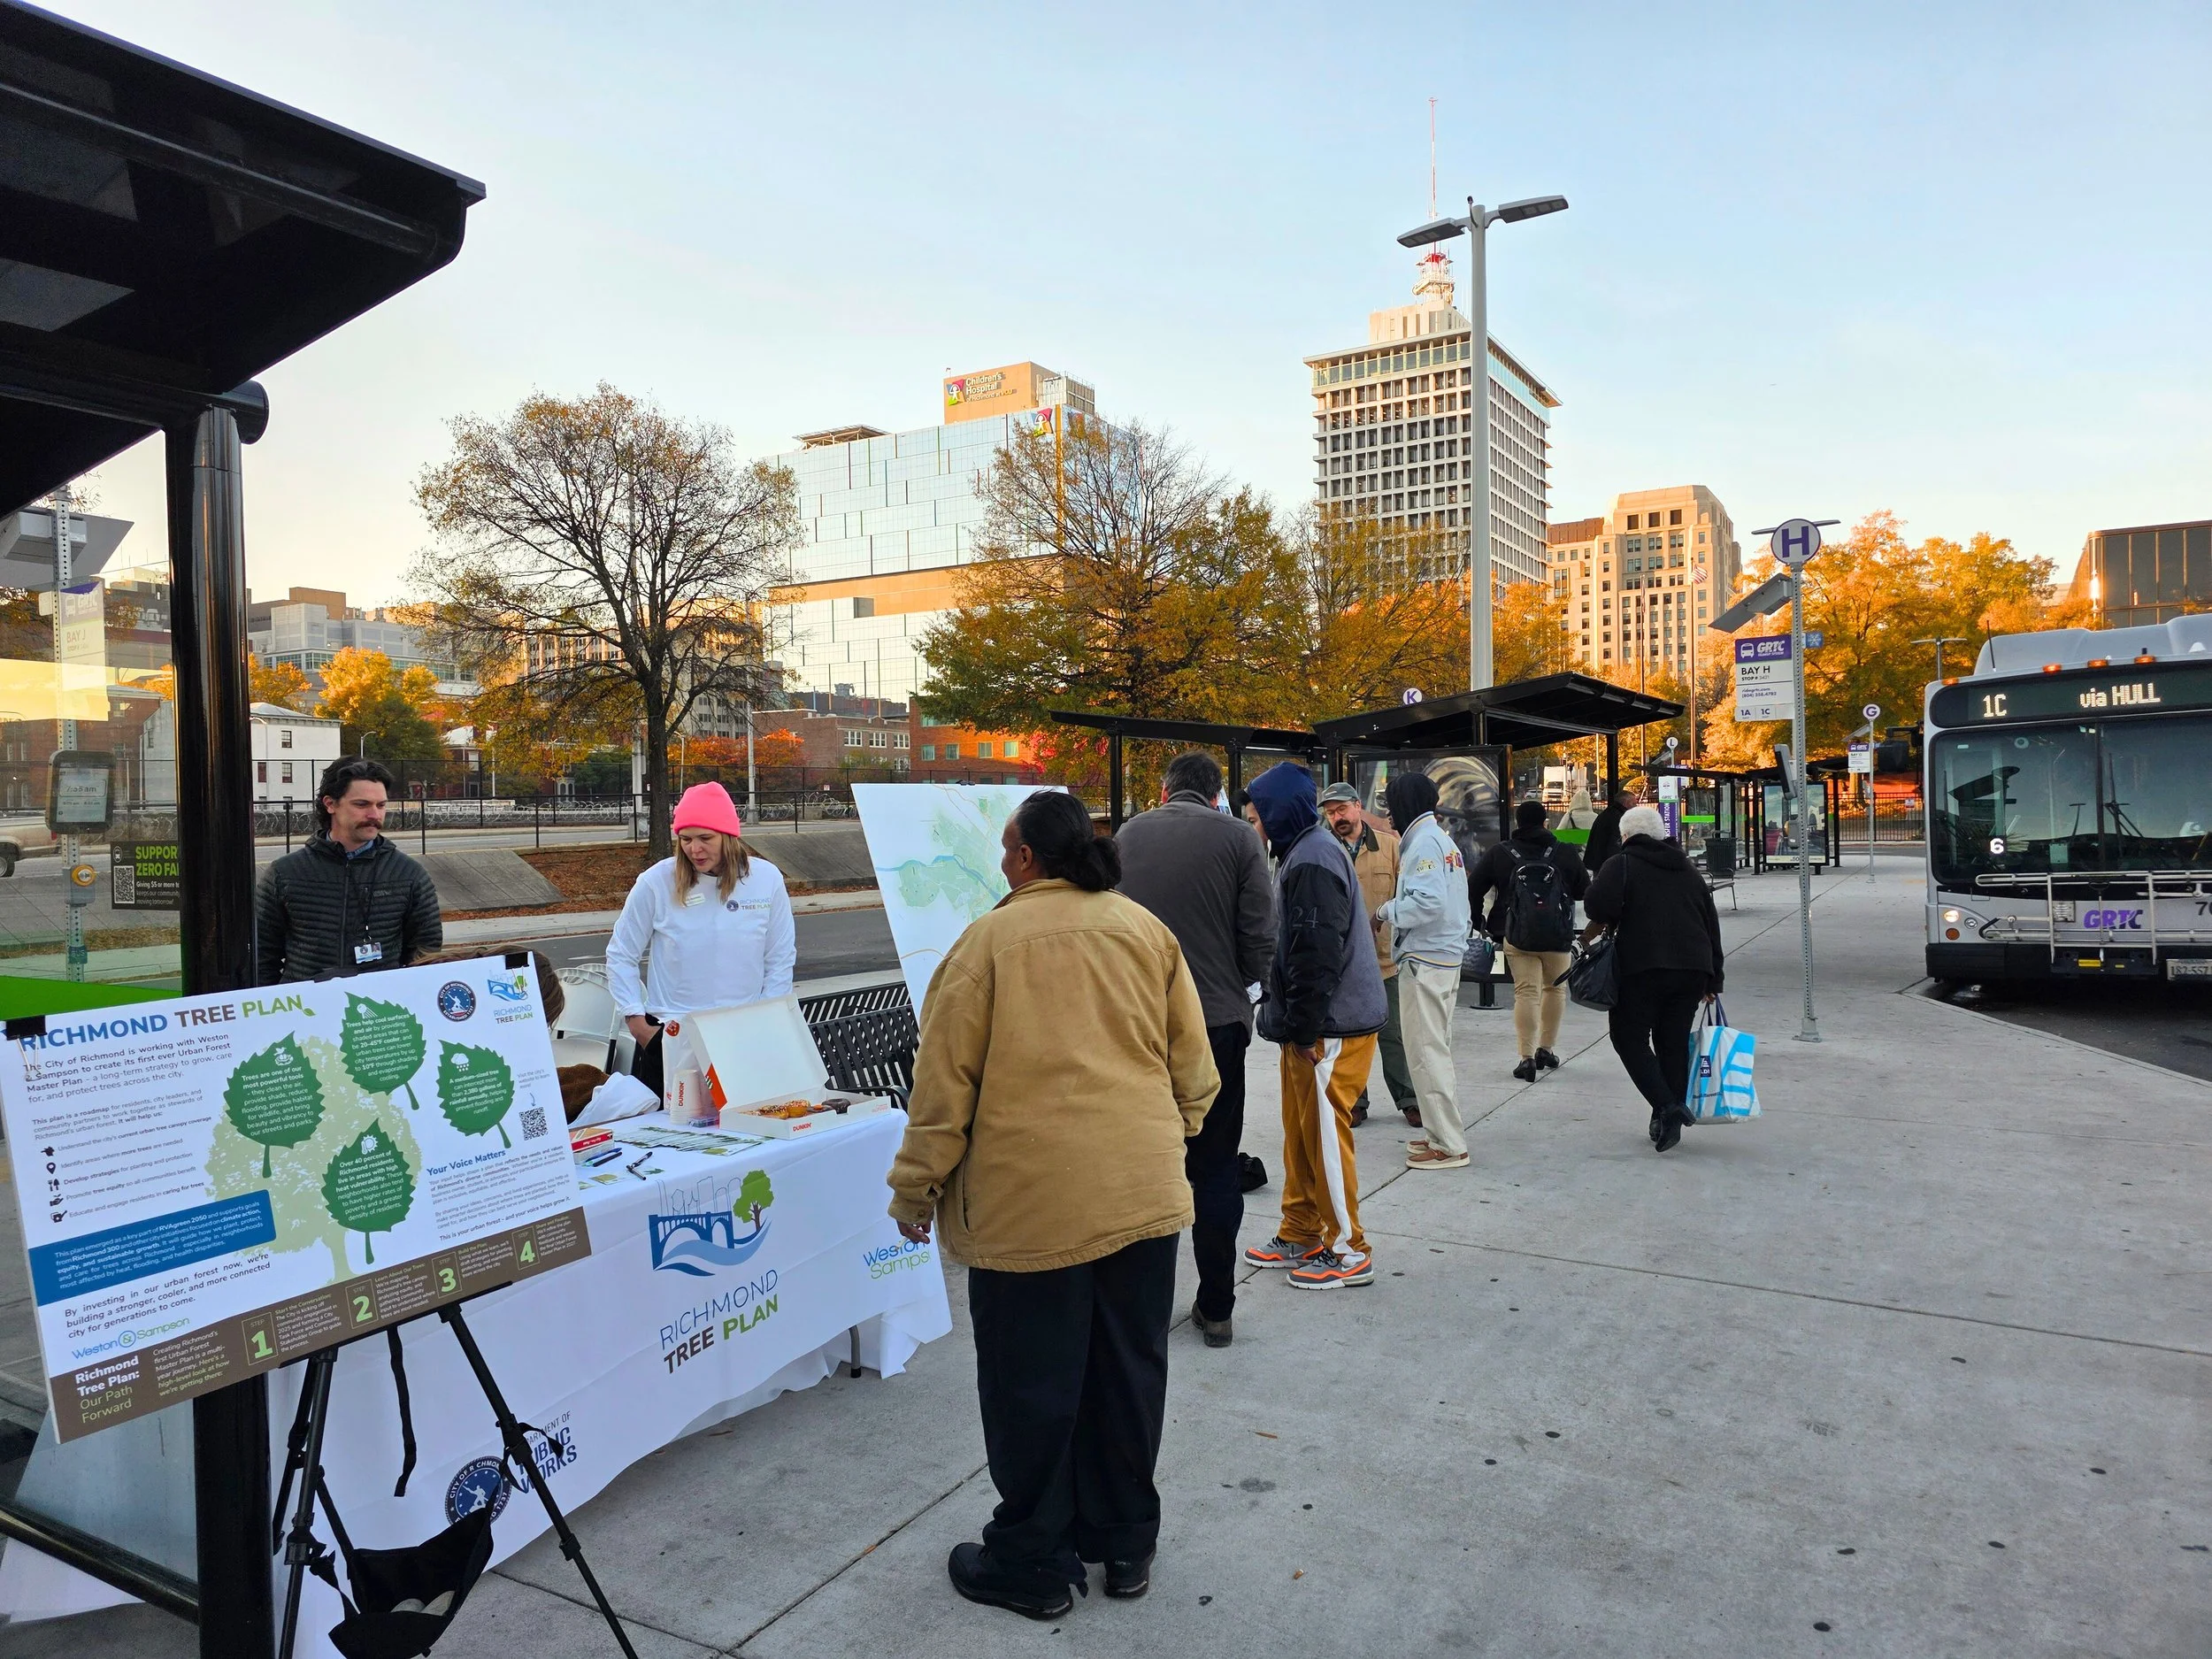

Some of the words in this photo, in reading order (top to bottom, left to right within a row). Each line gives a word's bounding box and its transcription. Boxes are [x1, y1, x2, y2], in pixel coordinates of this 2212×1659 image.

[965, 372, 1002, 387] Children's
[965, 382, 997, 396] Hospital
[1781, 526, 1810, 558] H
[66, 630, 81, 644] BAY
[1756, 641, 1786, 653] GRTC
[1741, 666, 1760, 675] BAY
[1407, 691, 1418, 703] K
[1983, 694, 2008, 718] 1C
[2079, 687, 2108, 708] via
[2112, 682, 2161, 706] HULL
[1866, 706, 1877, 717] G
[135, 846, 178, 860] SUPPOR
[1990, 838, 2005, 855] 6
[136, 863, 163, 876] ZERO
[2084, 909, 2143, 930] GRTC
[2195, 902, 2212, 916] 7
[173, 1004, 236, 1027] TREE
[242, 995, 303, 1018] PLAN
[494, 1004, 533, 1017] RICHMOND
[495, 1016, 514, 1025] TREE
[515, 1011, 534, 1020] PLAN
[34, 1067, 78, 1079] Sampson
[94, 1059, 121, 1070] create
[137, 1054, 154, 1063] first
[205, 1041, 230, 1051] Forest
[81, 1048, 125, 1062] Richmond
[139, 1042, 173, 1052] working
[176, 1037, 195, 1047] with
[198, 1033, 228, 1043] Weston
[27, 1082, 58, 1092] Master
[101, 1068, 142, 1079] long-term
[145, 1062, 178, 1071] strategy
[192, 1056, 213, 1065] grow,
[46, 1090, 63, 1099] and
[65, 1084, 96, 1097] protect
[99, 1081, 120, 1090] trees
[123, 1077, 150, 1086] across
[793, 1123, 811, 1132] DUNKIN'
[339, 1163, 368, 1175] Richmond
[369, 1156, 394, 1167] residents
[363, 1151, 385, 1163] percent
[427, 1165, 447, 1175] Your
[449, 1158, 472, 1169] Voice
[475, 1149, 505, 1163] Matters
[520, 1240, 535, 1263] 4
[871, 1251, 931, 1279] Samps
[83, 1294, 125, 1311] investing
[144, 1285, 158, 1294] our
[164, 1276, 188, 1287] urban
[194, 1266, 218, 1279] forest
[248, 1253, 268, 1263] we're
[438, 1268, 457, 1293] 3
[66, 1310, 104, 1326] building
[115, 1297, 154, 1312] stronger,
[157, 1288, 185, 1300] cooler,
[188, 1279, 204, 1291] and
[206, 1275, 227, 1286] more
[229, 1261, 270, 1279] connected
[68, 1327, 85, 1337] city
[88, 1323, 101, 1332] for
[104, 1307, 157, 1328] generations
[170, 1296, 195, 1307] come.
[353, 1295, 373, 1323] 2
[660, 1269, 779, 1351] RICHMOND
[72, 1340, 118, 1359] Weston
[122, 1333, 132, 1344] &
[137, 1317, 189, 1340] Sampson
[251, 1330, 273, 1358] 1
[664, 1325, 715, 1374] TREE
[723, 1294, 780, 1340] PLAN
[75, 1356, 139, 1385] Richmond
[77, 1383, 105, 1397] Tree
[108, 1371, 140, 1387] Plan:
[80, 1397, 102, 1410] Our
[105, 1385, 133, 1402] Path
[81, 1399, 132, 1424] Forward
[561, 1410, 571, 1423] OF
[449, 1481, 460, 1499] CITY
[459, 1470, 468, 1480] OF
